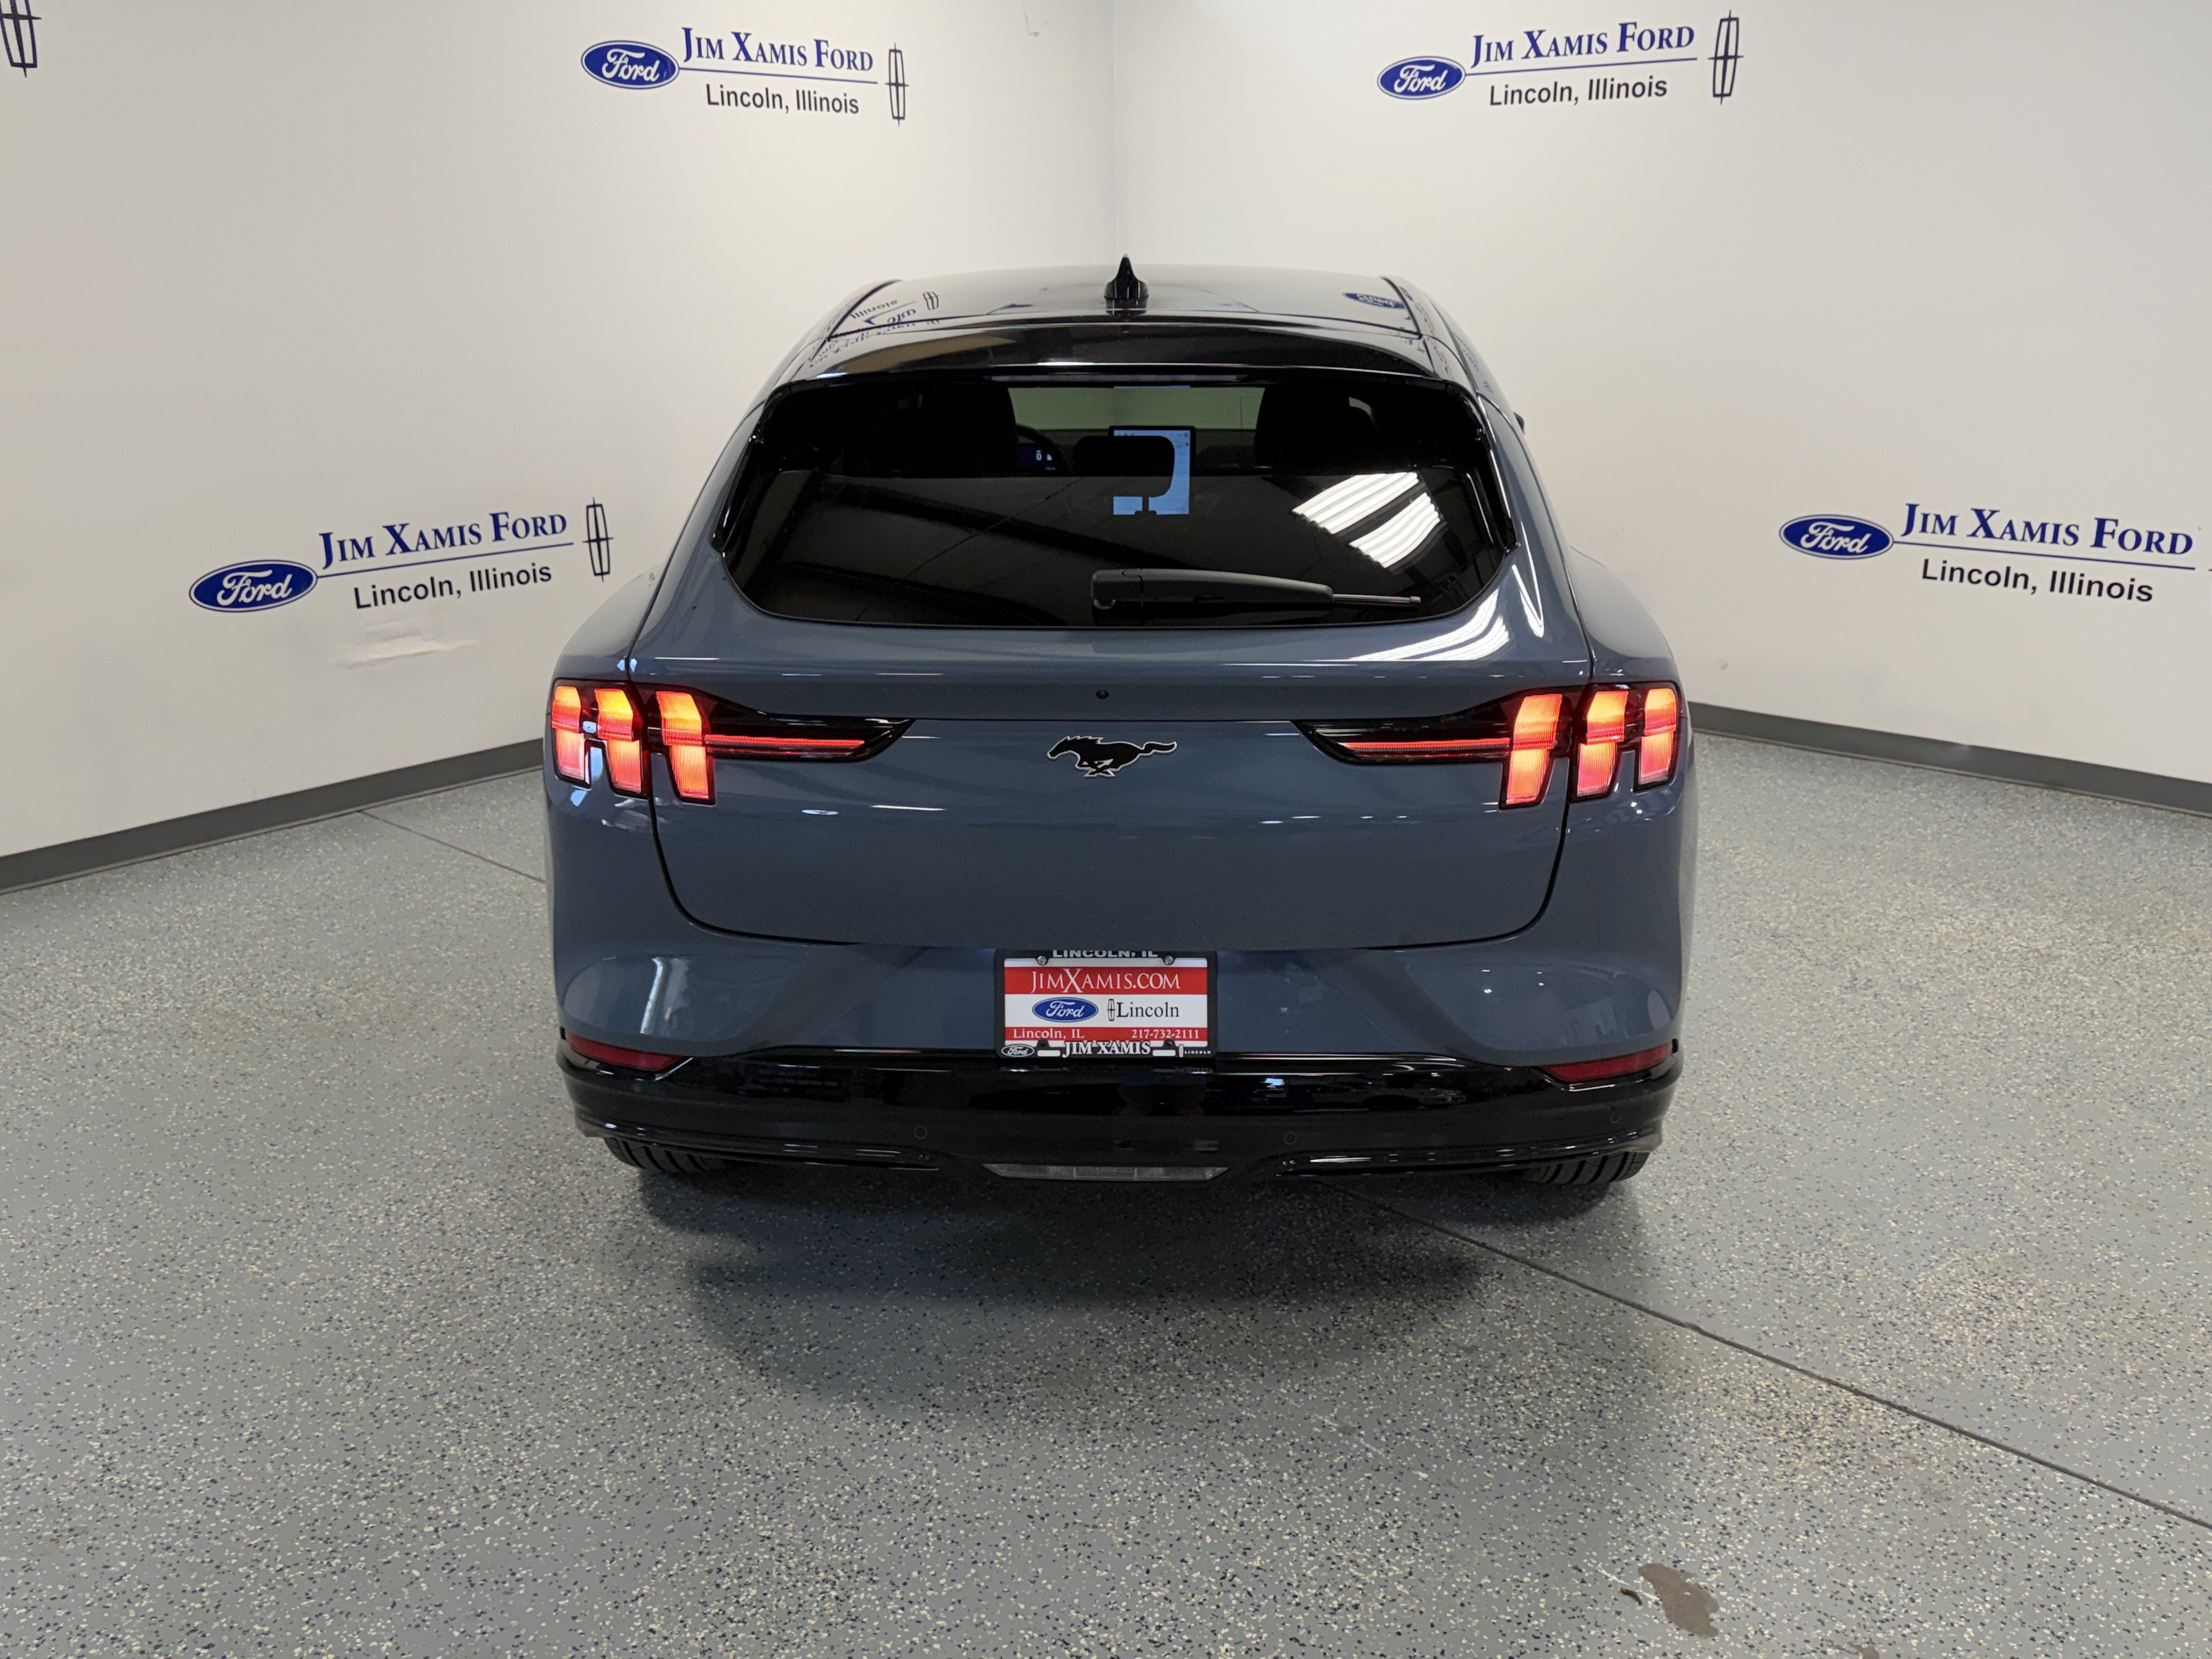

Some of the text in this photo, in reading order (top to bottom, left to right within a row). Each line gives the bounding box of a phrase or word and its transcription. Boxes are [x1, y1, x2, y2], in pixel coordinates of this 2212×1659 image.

[681, 26, 873, 71] JIM XAMIS FORD
[1470, 21, 1695, 69] JIM XAMIS FORD
[603, 48, 661, 82] Ford
[1394, 64, 1446, 93] Ford
[706, 83, 860, 115] Lincoln, Illinois
[1489, 75, 1668, 106] Lincoln, Illinois
[318, 511, 567, 569] JIM XAMIS FORD
[1800, 522, 1869, 554] Ford
[1900, 503, 2193, 555] JIM XAMIS FORD
[217, 569, 293, 606] Ford
[353, 562, 552, 610] Lincoln, Illinois
[1922, 558, 2153, 602] Lincoln, Illinois
[1046, 1001, 1085, 1018] Ford
[1116, 1001, 1180, 1018] Lincoln
[1013, 1028, 1085, 1040] Lincoln, IL
[1063, 1041, 1151, 1058] JIM XAMIS
[1131, 1029, 1199, 1039] 217-732-2111
[1007, 1046, 1029, 1056] Ford
